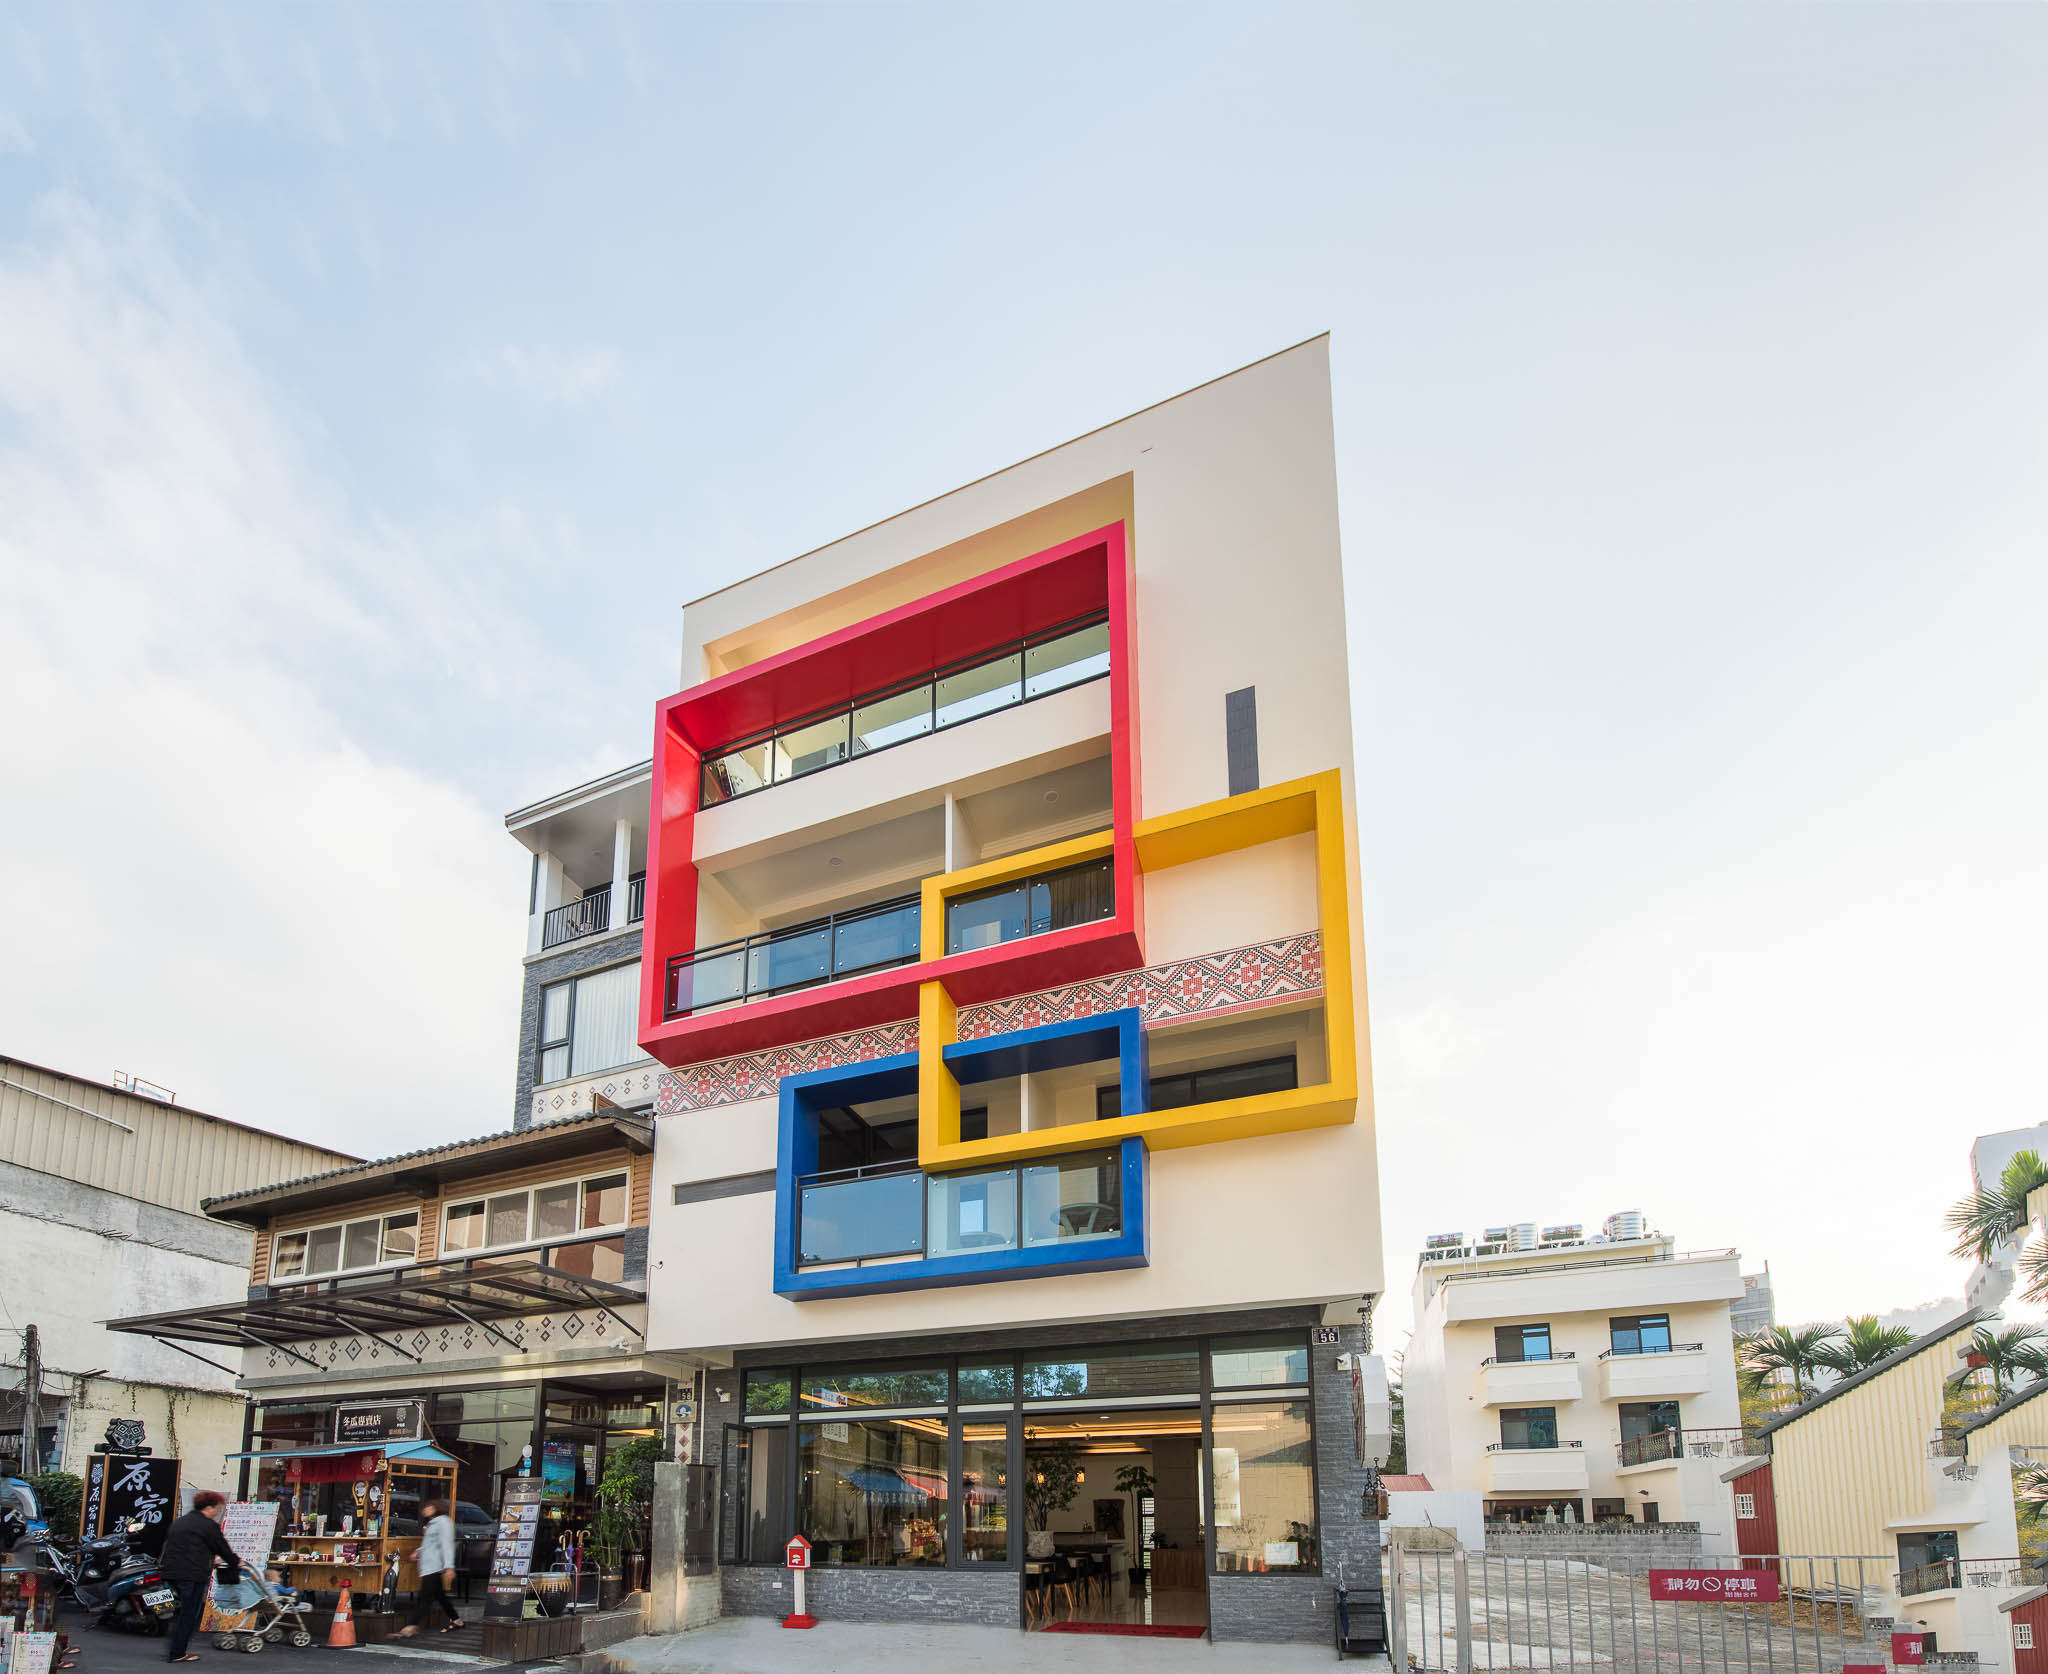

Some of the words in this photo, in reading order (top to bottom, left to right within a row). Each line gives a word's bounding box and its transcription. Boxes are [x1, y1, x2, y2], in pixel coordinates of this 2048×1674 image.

[1320, 1333, 1335, 1343] 56
[681, 1392, 691, 1400] 58
[1666, 1577, 1700, 1591] 請勿
[1724, 1577, 1757, 1591] 停車
